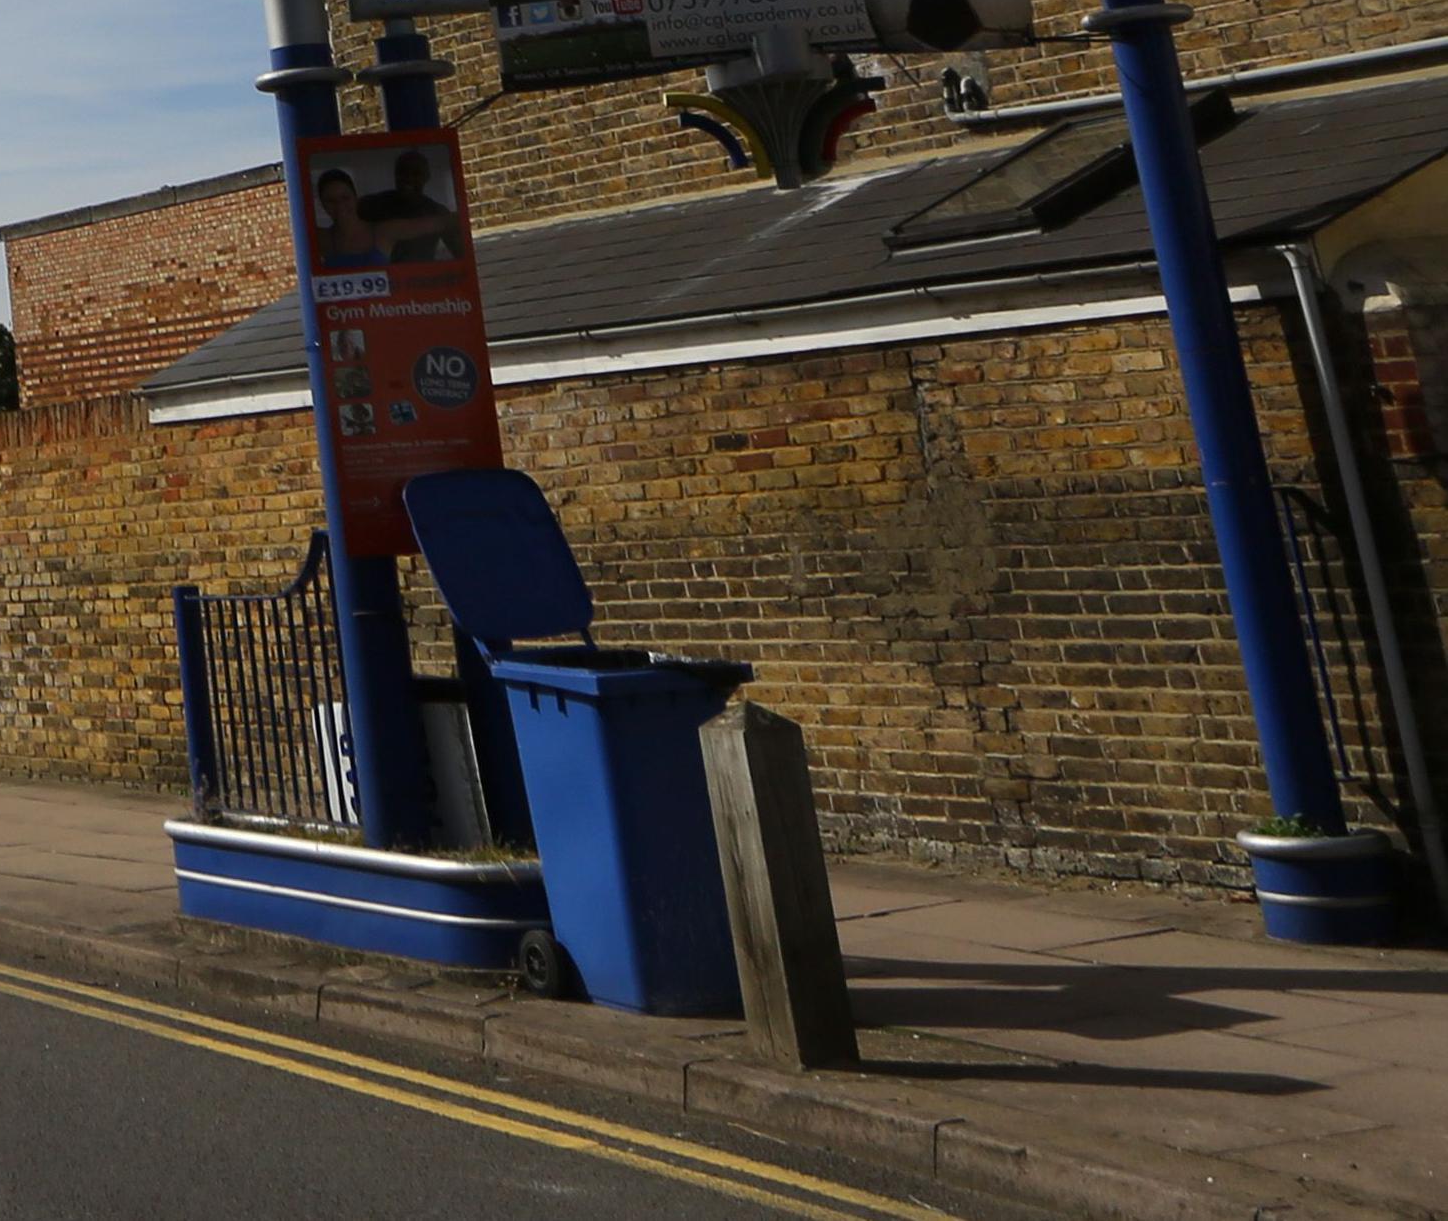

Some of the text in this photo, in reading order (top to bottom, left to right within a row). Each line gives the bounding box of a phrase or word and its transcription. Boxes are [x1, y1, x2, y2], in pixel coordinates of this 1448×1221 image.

[652, 0, 867, 31] info@cgkacademy.co.uk
[318, 277, 387, 298] £19.99
[326, 297, 473, 323] Gym Membership
[426, 354, 466, 377] NO
